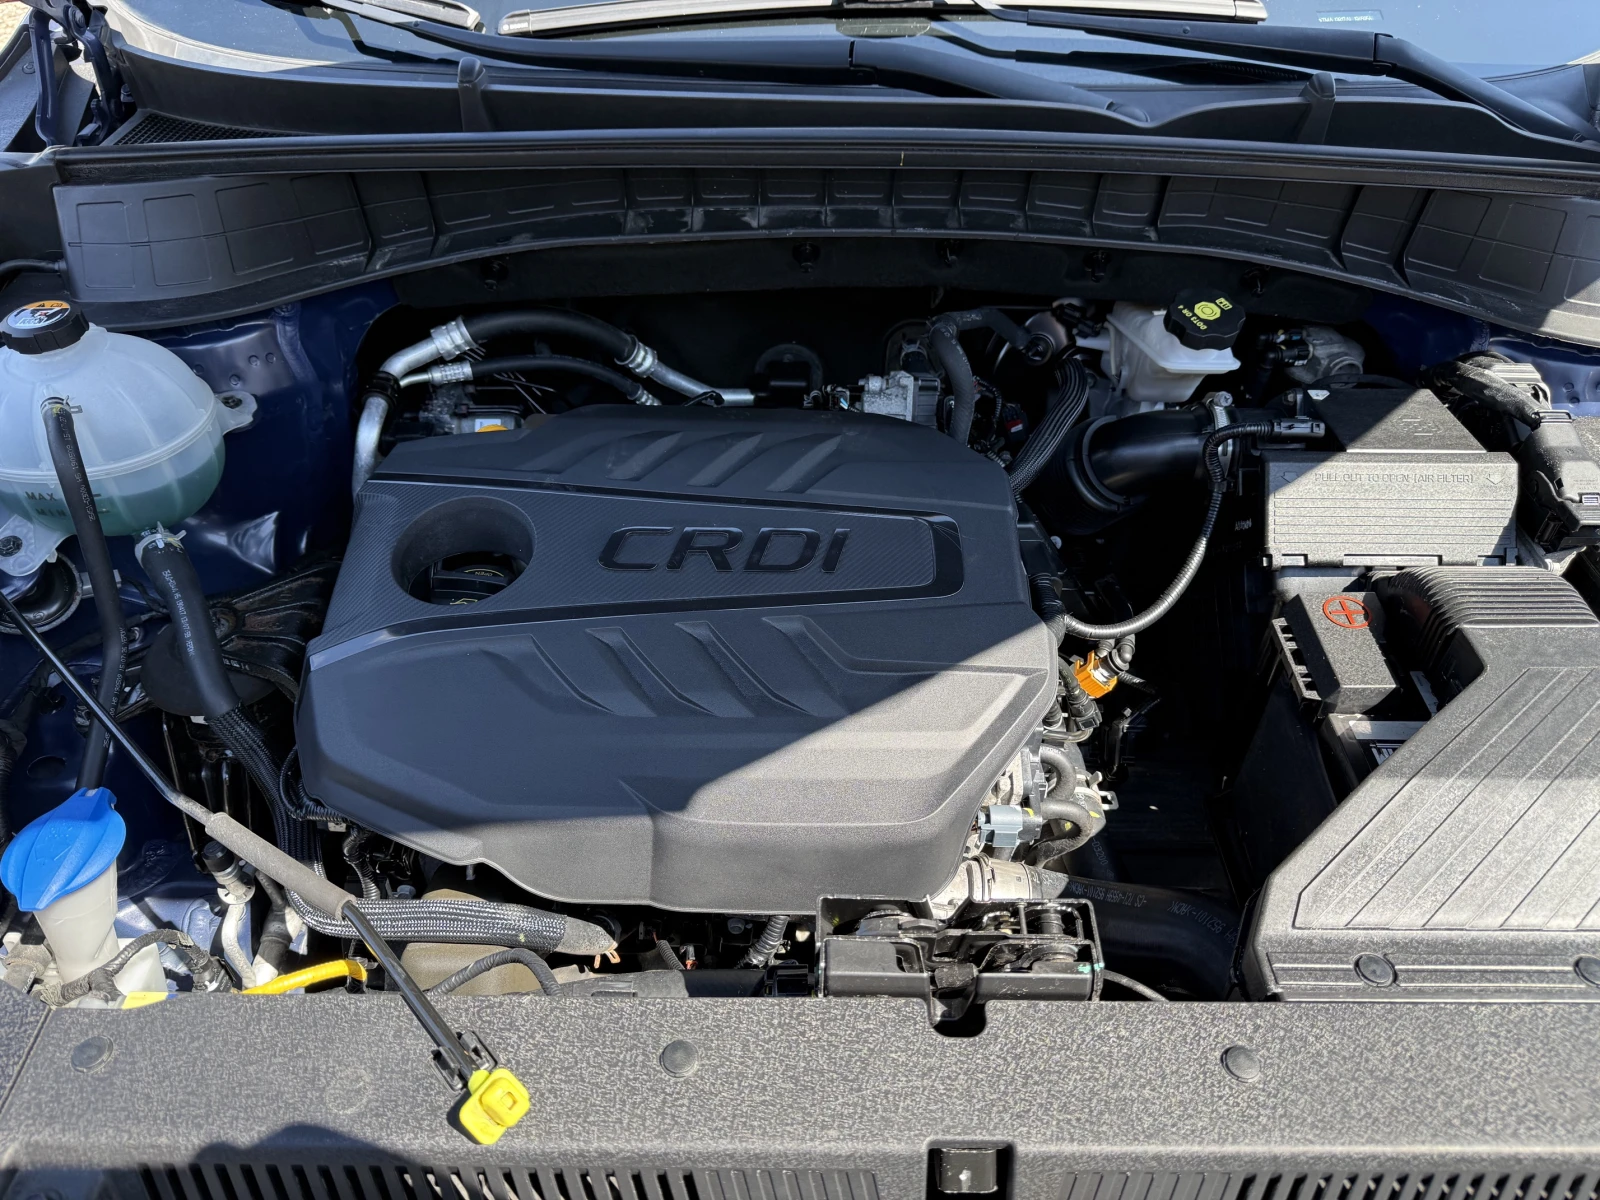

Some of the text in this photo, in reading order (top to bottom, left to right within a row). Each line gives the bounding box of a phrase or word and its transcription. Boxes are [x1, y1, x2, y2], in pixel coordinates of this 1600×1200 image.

[1181, 308, 1193, 317] OR
[1190, 316, 1207, 330] DOT3
[1314, 473, 1338, 482] PULL
[1342, 473, 1364, 482] OUT
[1367, 473, 1380, 483] TO
[1382, 473, 1410, 483] OPEN
[25, 491, 57, 501] MAX
[36, 508, 68, 517] MIN
[597, 526, 851, 573] CRDI
